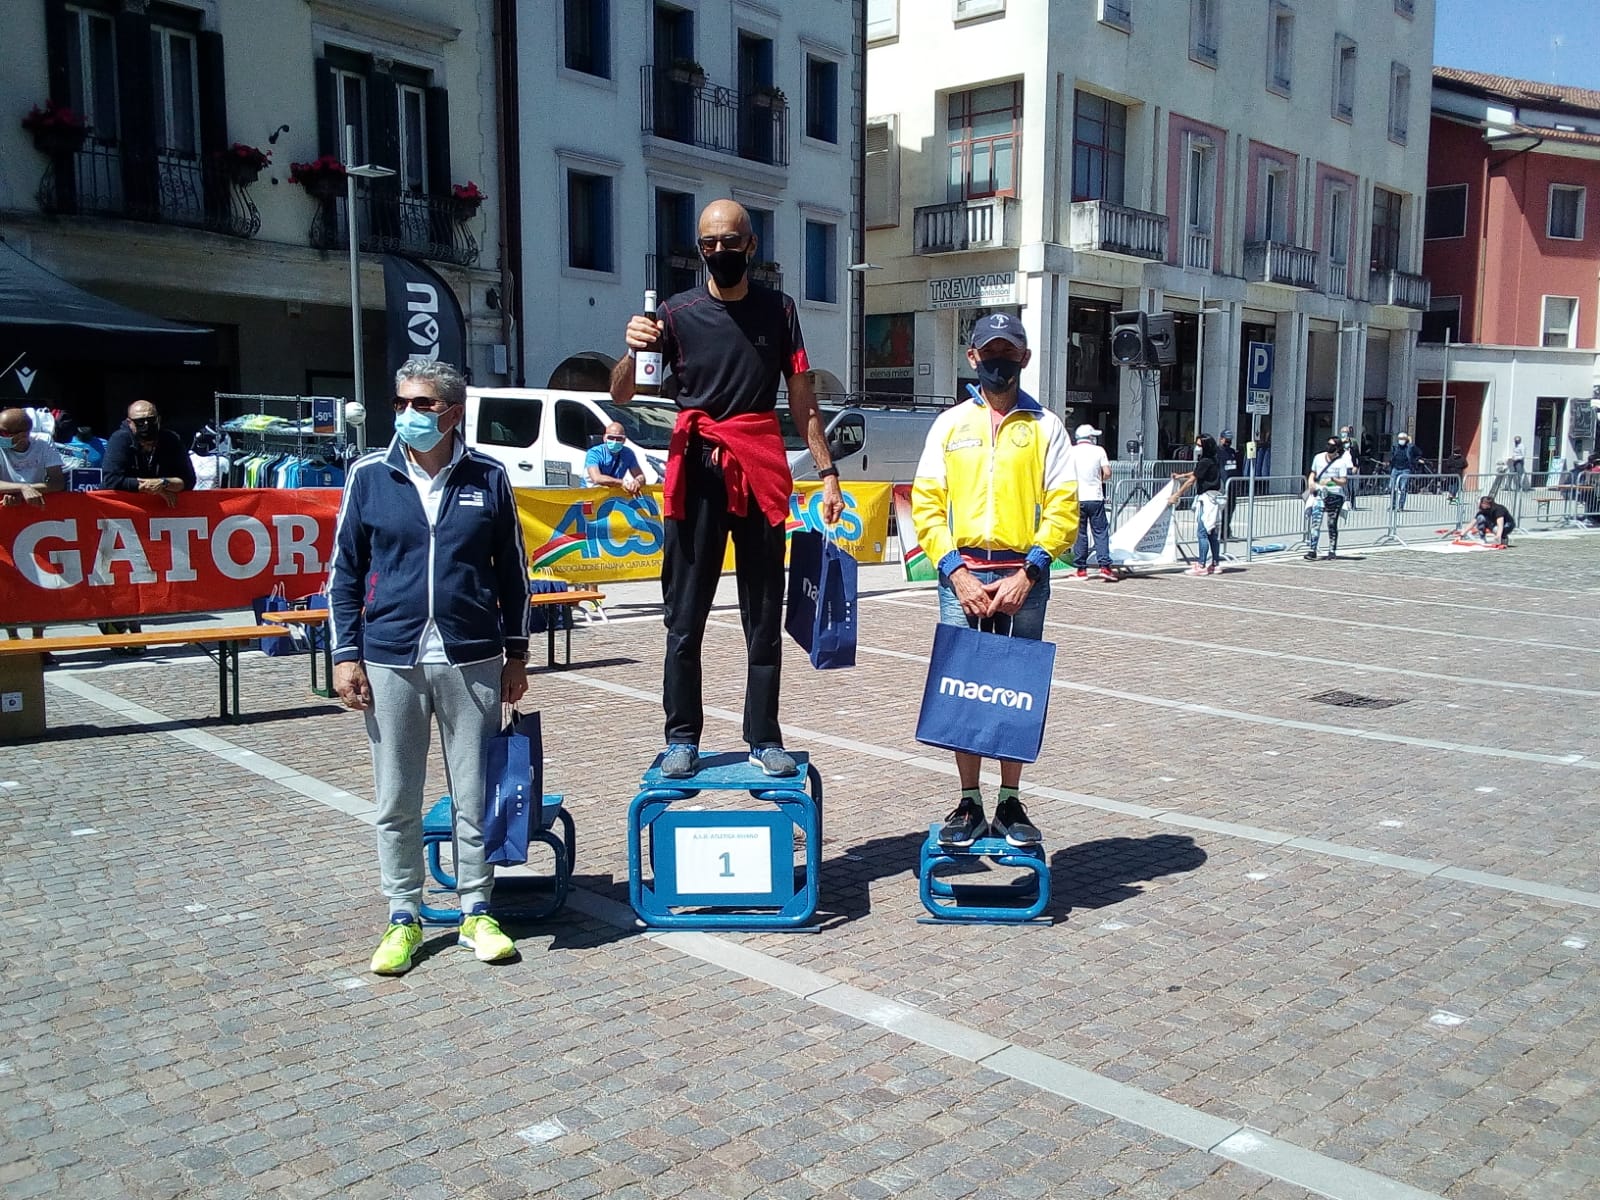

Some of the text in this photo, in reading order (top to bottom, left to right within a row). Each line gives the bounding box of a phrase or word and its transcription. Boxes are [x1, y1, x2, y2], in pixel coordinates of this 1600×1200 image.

[930, 273, 1011, 300] TREVISAN
[1254, 348, 1268, 384] P
[13, 515, 333, 589] GATOR
[939, 676, 1033, 711] macron
[719, 852, 735, 877] 1
